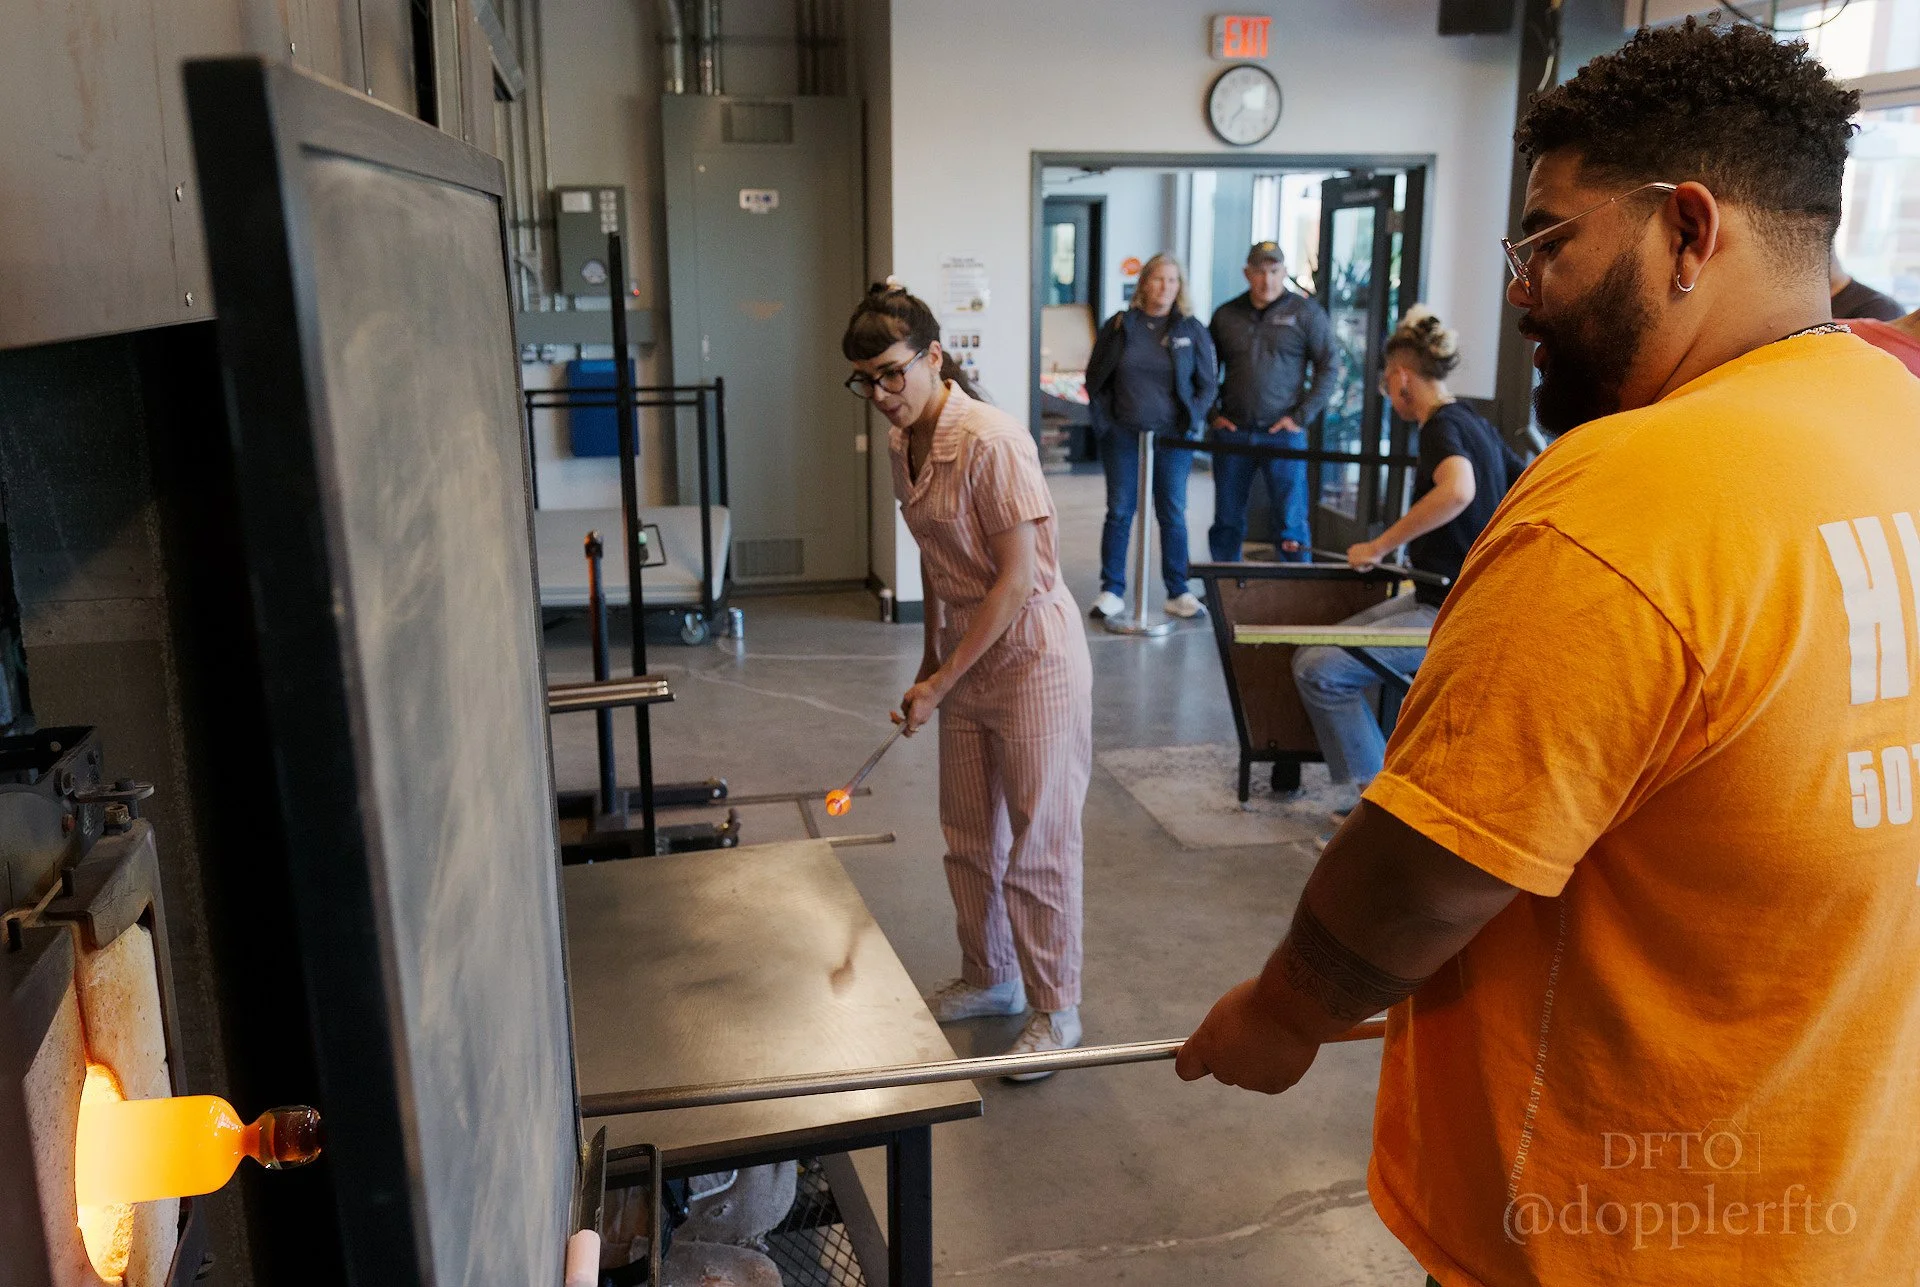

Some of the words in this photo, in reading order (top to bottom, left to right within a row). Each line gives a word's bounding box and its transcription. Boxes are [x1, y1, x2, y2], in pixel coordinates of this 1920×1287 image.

[1223, 15, 1272, 58] EXIT
[1549, 954, 1562, 986] TAKE
[1541, 989, 1555, 1036] WOULD
[1536, 1037, 1549, 1064] HOP
[1533, 1064, 1545, 1087] HIP
[1526, 1088, 1541, 1121] THAT
[1511, 1122, 1534, 1182] THOUGHT
